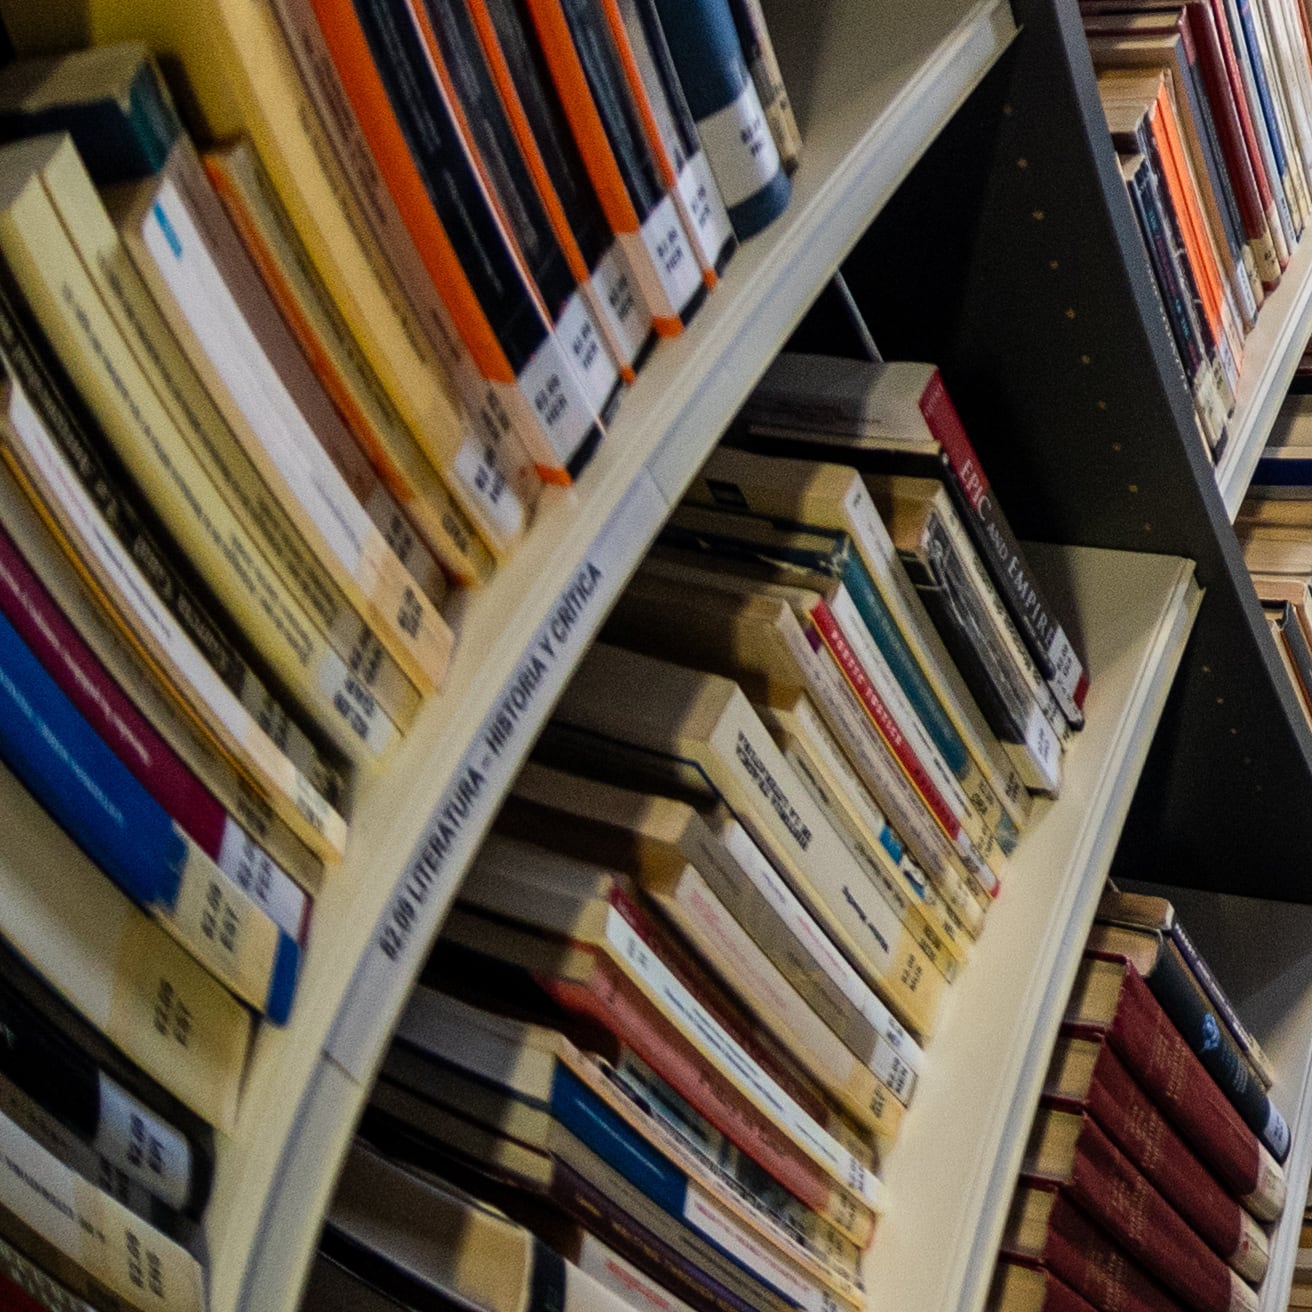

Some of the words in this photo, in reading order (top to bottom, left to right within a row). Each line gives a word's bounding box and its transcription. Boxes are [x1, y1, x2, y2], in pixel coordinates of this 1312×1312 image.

[953, 460, 999, 523] EPIC
[982, 521, 1011, 560] AND
[535, 637, 559, 658] Y
[542, 558, 608, 645] CRÍTICA
[477, 653, 553, 757] HISTORIA
[400, 765, 489, 904] LITERATURA
